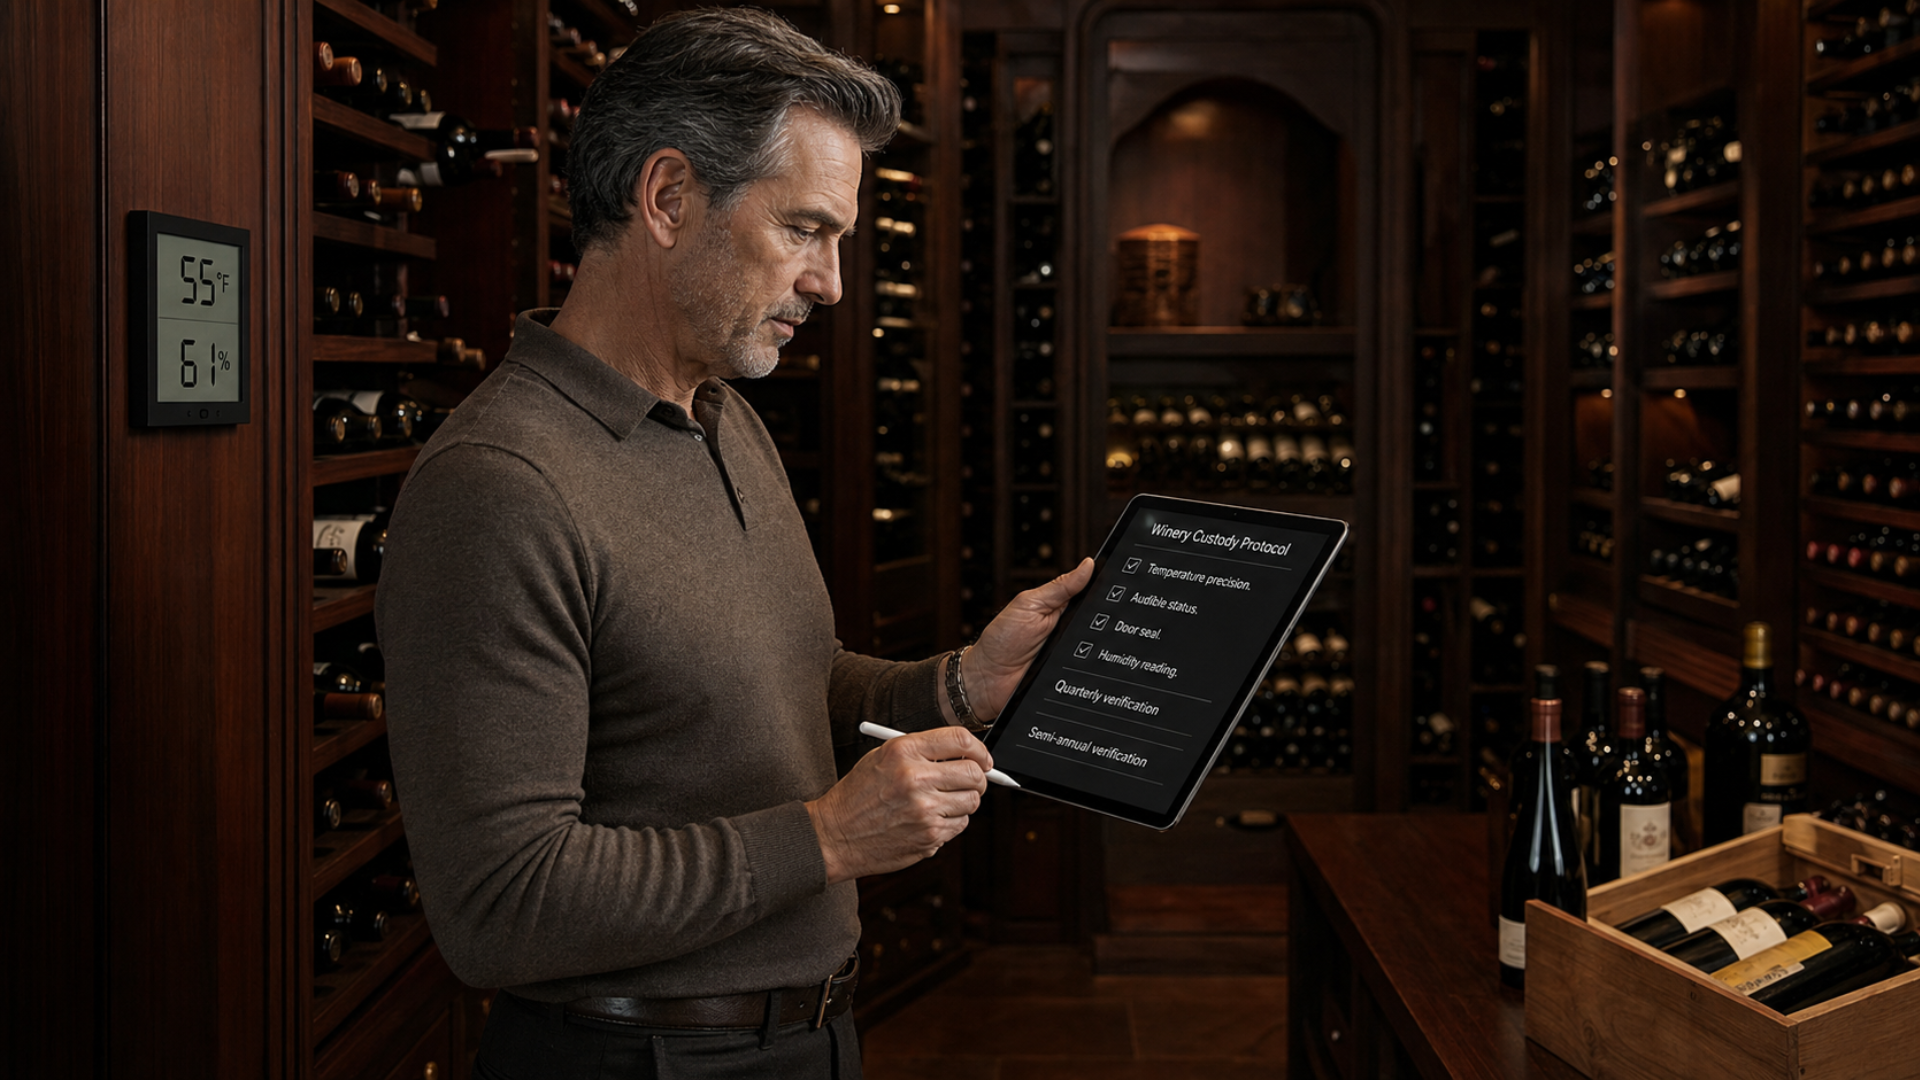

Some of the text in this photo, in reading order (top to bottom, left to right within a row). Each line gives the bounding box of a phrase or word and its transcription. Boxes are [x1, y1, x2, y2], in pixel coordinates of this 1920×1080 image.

[180, 338, 231, 389] 61%
[1151, 522, 1292, 556] Winery Custody Protocol
[1147, 562, 1251, 591] Temperature precision.
[1129, 591, 1198, 615] Audible status.
[1114, 620, 1162, 640] Door seal.
[1097, 649, 1178, 679] Humidity reading.
[1054, 679, 1160, 716] Quarterly verification
[1027, 726, 1148, 768] Semi-annual verification
